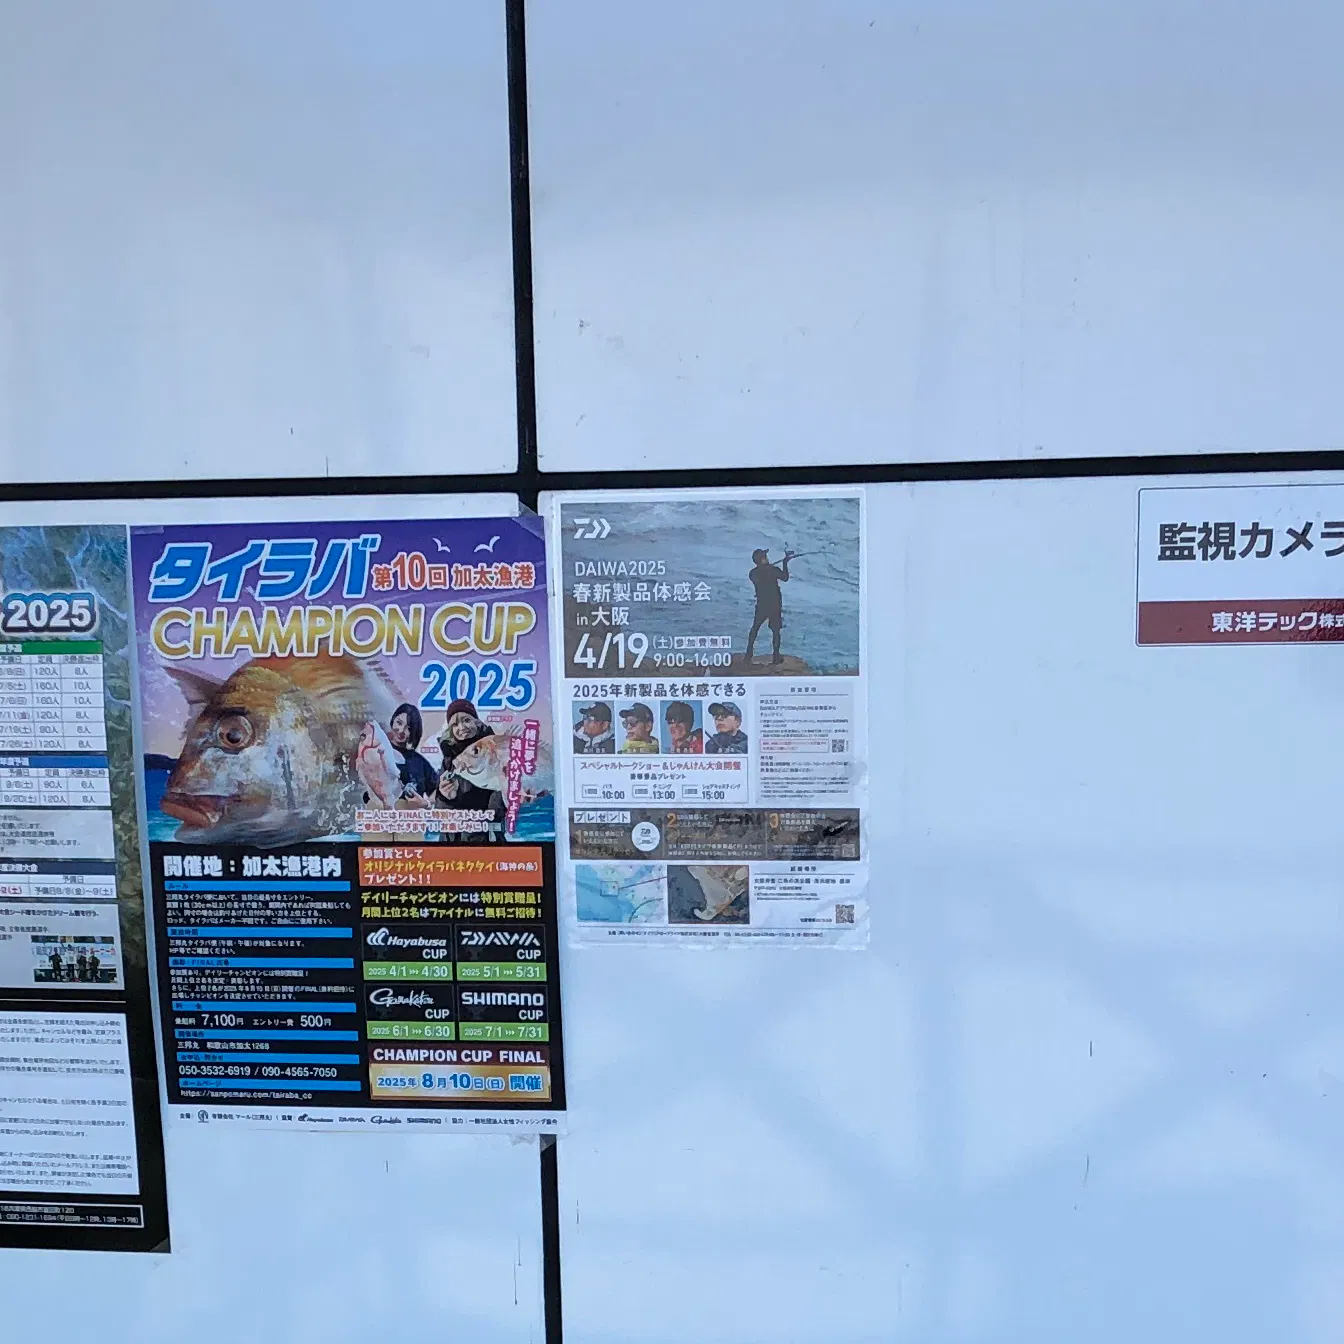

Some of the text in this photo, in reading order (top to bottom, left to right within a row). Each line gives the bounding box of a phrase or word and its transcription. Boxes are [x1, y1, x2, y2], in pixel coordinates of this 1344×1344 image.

[148, 535, 536, 601] タイラバ 第10回 加太漁港
[575, 560, 666, 576] DAIWA2025
[573, 582, 712, 603] 春新製品体感会
[3, 599, 94, 629] 2025
[576, 606, 629, 626] in 大阪
[152, 602, 536, 659] CHAMPION CUP
[573, 632, 649, 669] 4/19
[652, 636, 673, 649] (土)
[74, 682, 91, 690] 10人
[421, 661, 537, 711] 2025
[573, 683, 746, 699] 2025年新製品を体感できる
[74, 697, 92, 705] 10人
[602, 790, 625, 800] 10:00
[652, 791, 675, 800] 13:00
[702, 791, 725, 800] 15:00
[575, 812, 629, 822] プレゼント
[666, 813, 676, 828] 2
[770, 812, 779, 828] 3
[363, 849, 424, 859] 参加賞として
[387, 935, 446, 948] Hayabusa
[423, 949, 447, 959] CUP
[516, 949, 541, 959] CUP
[389, 965, 406, 977] 4/1
[421, 966, 448, 977] 4/30
[483, 966, 500, 977] 5/1
[516, 966, 540, 978] 5/31
[462, 992, 544, 1006] SHIMANO
[425, 1009, 450, 1019] CUP
[519, 1010, 543, 1020] CUP
[201, 1014, 244, 1028] 7,100円
[300, 1015, 331, 1028] 500円
[392, 1025, 409, 1036] 6/1
[424, 1025, 450, 1037] 6/30
[485, 1026, 502, 1037] 7/1
[518, 1026, 542, 1038] 7/31
[373, 1049, 545, 1063] CHAMPION CUP FINAL
[179, 1066, 251, 1076] 050-3532-6919
[509, 1075, 543, 1091] 開催
